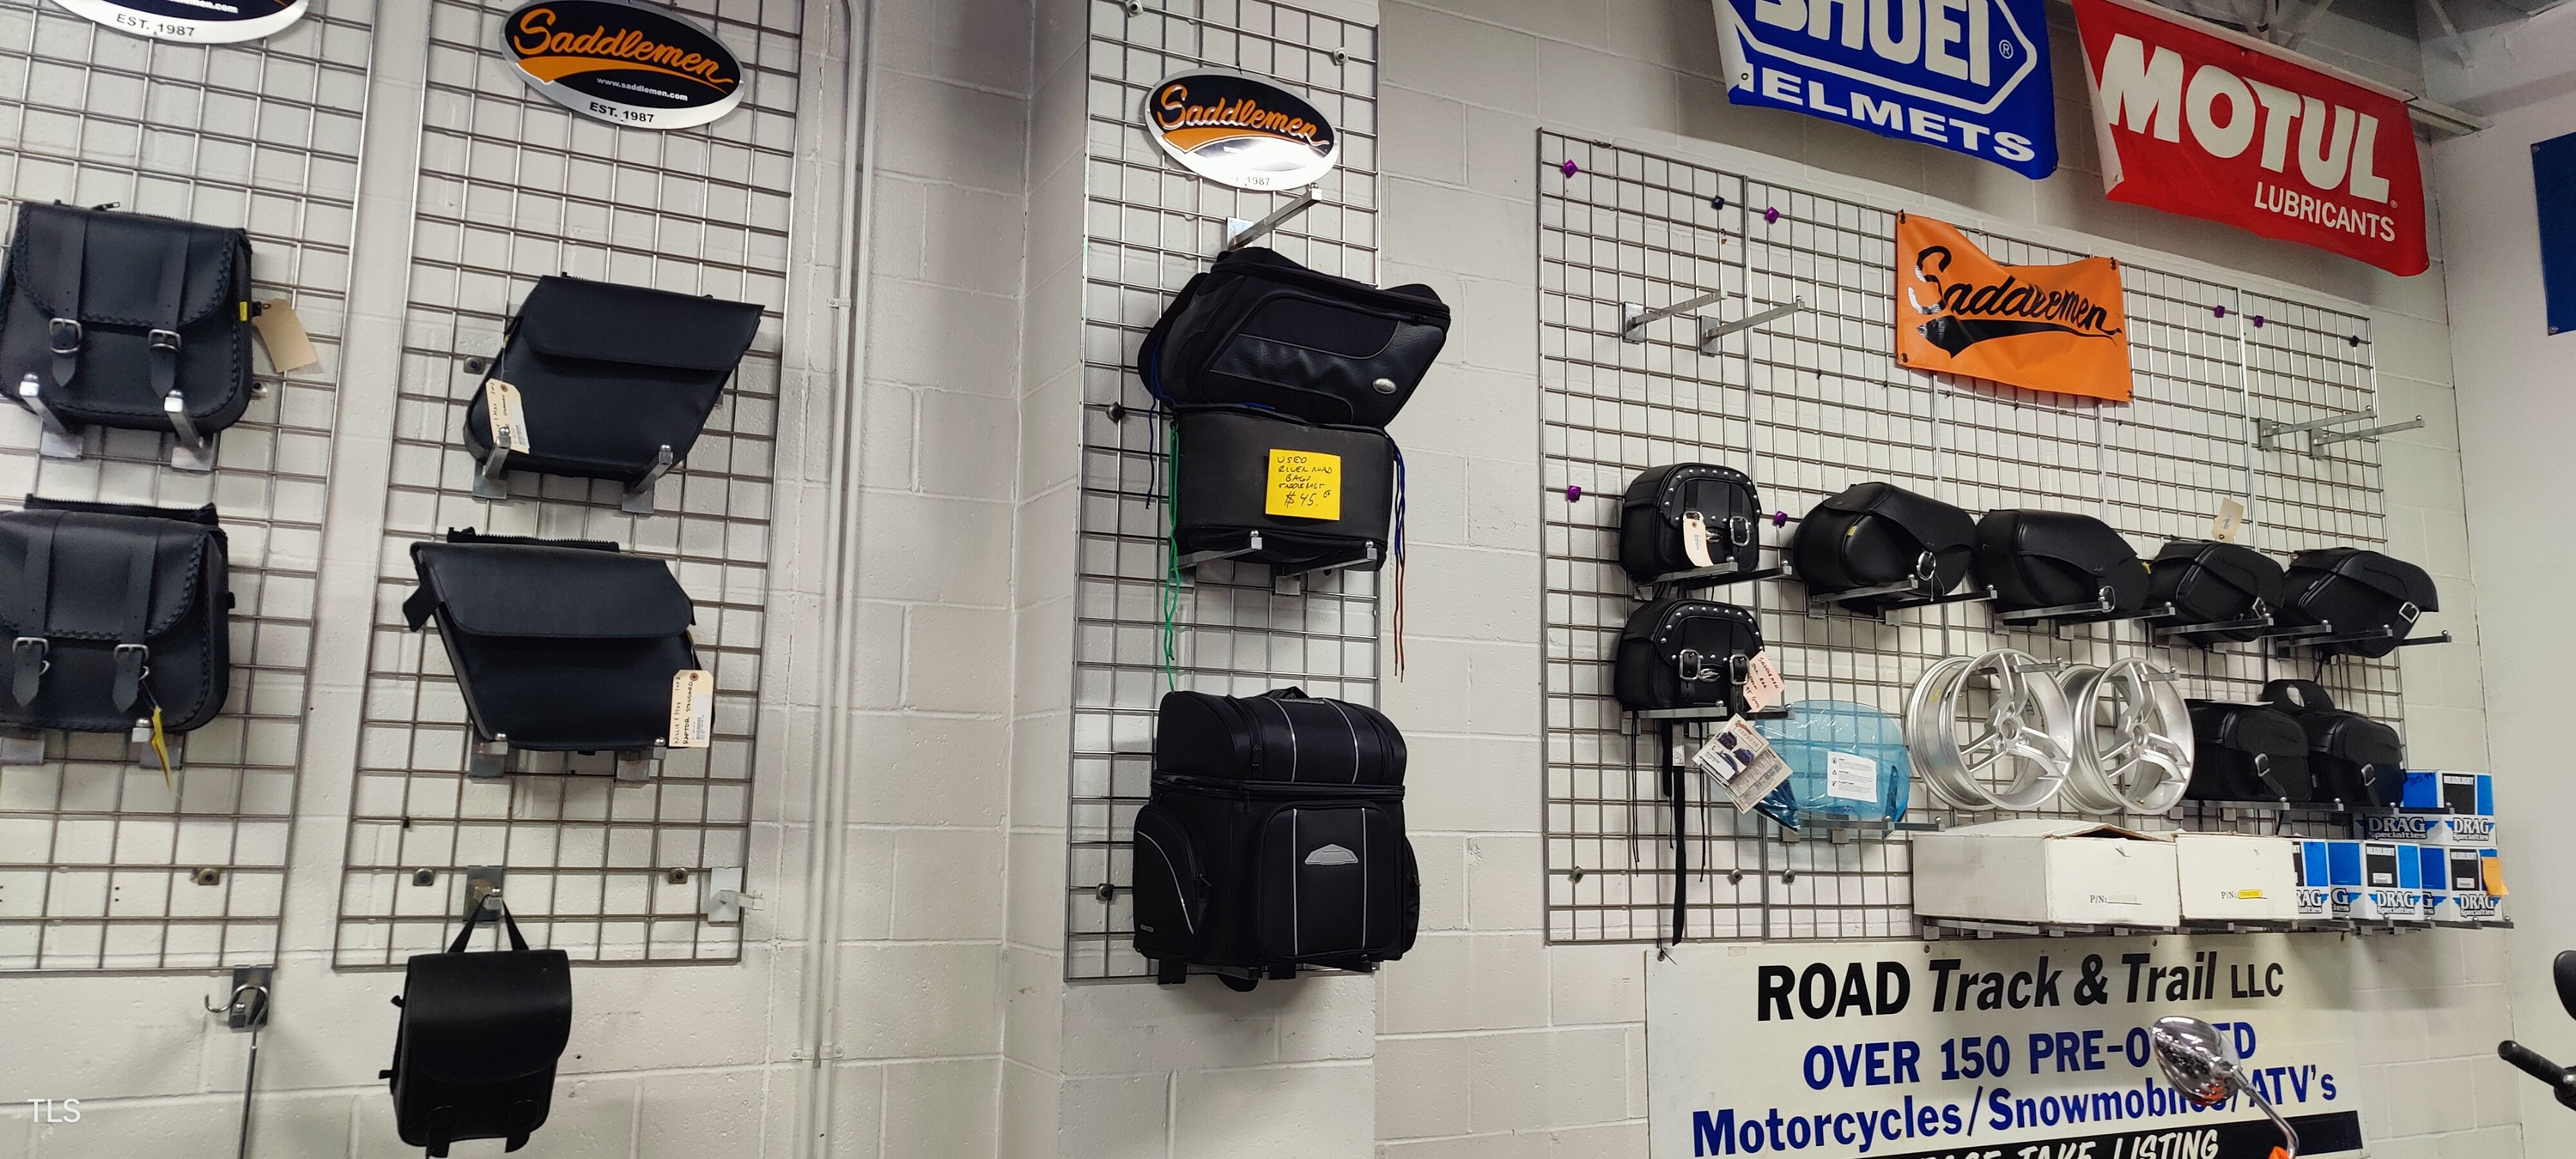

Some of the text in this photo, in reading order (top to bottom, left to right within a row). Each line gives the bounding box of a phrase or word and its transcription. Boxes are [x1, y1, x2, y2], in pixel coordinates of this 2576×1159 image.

[116, 13, 195, 36] EST. 1987
[513, 8, 734, 83] Saddlemen
[597, 77, 688, 101] www.saddlemen.com
[589, 101, 654, 124] EST. 1987
[1157, 83, 1329, 146] Saddlemen
[2100, 33, 2390, 203] MOTUL
[1247, 176, 1270, 185] 1987
[2255, 182, 2396, 242] LUBRICANTS
[1285, 474, 1311, 482] BAGS
[2368, 817, 2427, 833] DRAG
[2453, 818, 2489, 834] DRAG
[2090, 895, 2107, 904] P/N:
[2296, 889, 2322, 907] RAG
[2377, 890, 2415, 907] DRAG
[2460, 894, 2494, 910] DRAG
[1758, 951, 2283, 1021] ROAD Track & Trail LLC
[1803, 1022, 2256, 1090] OVER 150 PRE-OD
